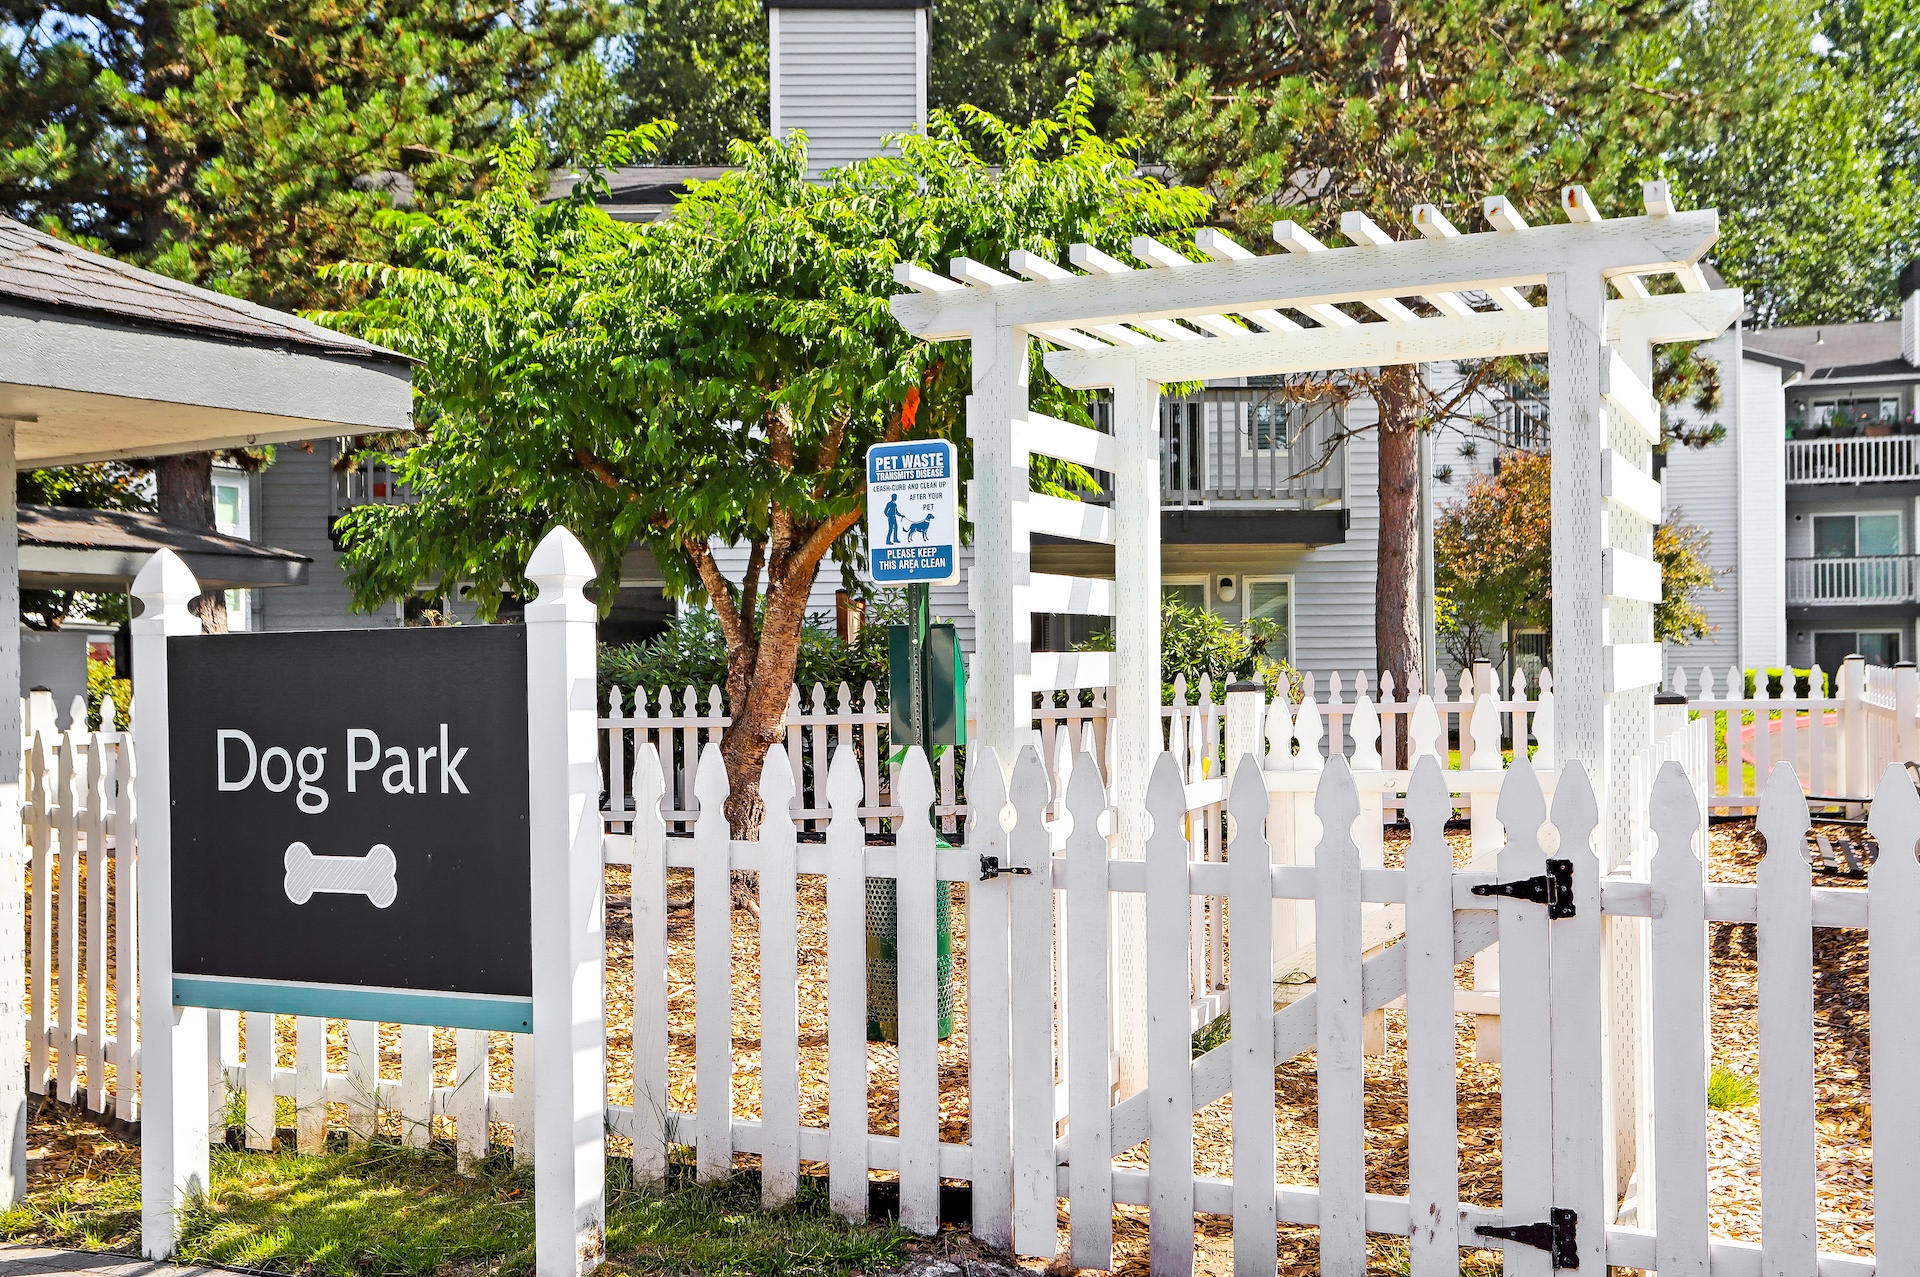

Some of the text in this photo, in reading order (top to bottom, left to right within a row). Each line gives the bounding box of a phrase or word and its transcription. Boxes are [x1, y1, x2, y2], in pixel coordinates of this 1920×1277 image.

[875, 452, 944, 470] PET WASTE
[876, 468, 944, 481] TRANSMITS DISEASE
[873, 484, 906, 492] LEASH-CURB
[908, 482, 919, 490] AND
[920, 481, 937, 489] CLEAN
[928, 492, 943, 500] YOUR
[887, 547, 937, 559] PLEASE KEEP
[879, 558, 946, 570] THIS AREA CLEAN
[216, 723, 471, 814] Dog Park
